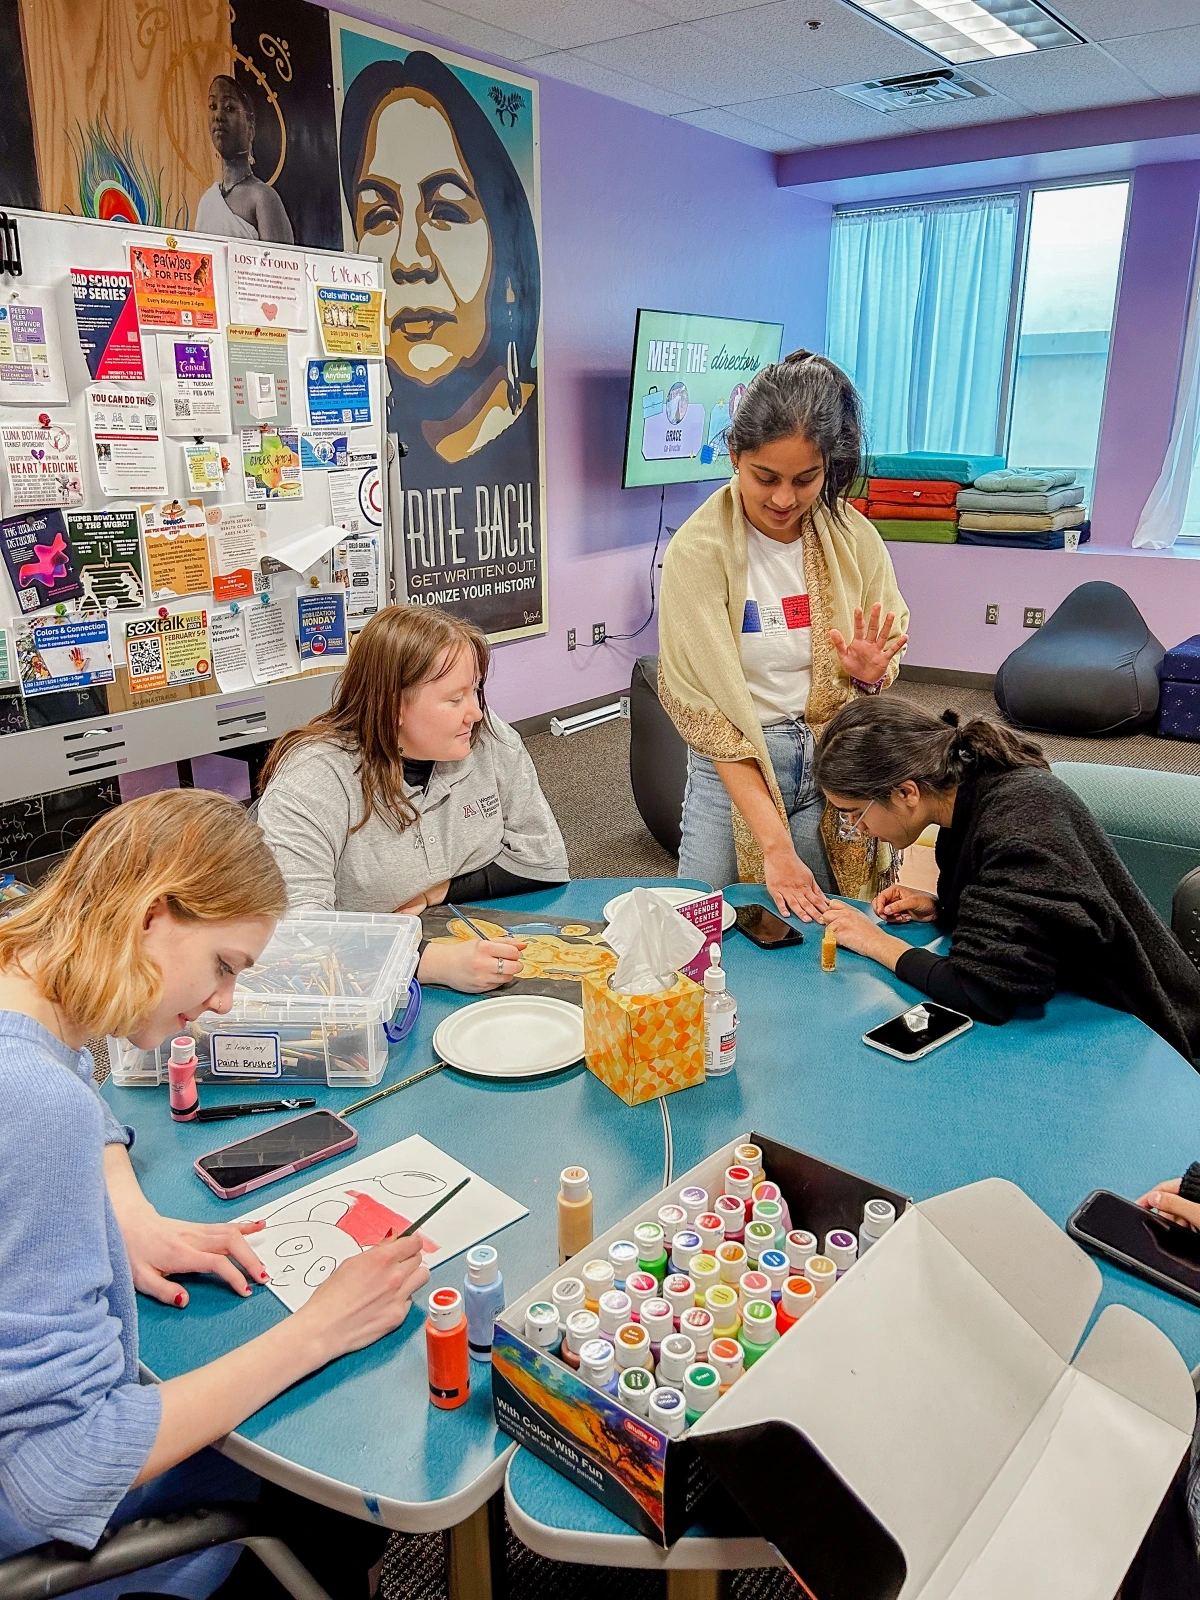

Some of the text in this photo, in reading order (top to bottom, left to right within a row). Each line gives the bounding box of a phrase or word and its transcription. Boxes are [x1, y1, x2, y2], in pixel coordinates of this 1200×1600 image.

[153, 254, 191, 270] Pa(w)se
[234, 254, 298, 270] LOST & FOUND
[71, 273, 132, 288] RAD SCHOOL
[156, 270, 192, 281] FOR PETS
[332, 266, 373, 286] EVENTS
[89, 288, 127, 300] SERIES
[320, 290, 336, 299] Chats
[350, 293, 368, 302] Cats!
[647, 340, 760, 374] MEET THE directors
[91, 394, 150, 405] YOU CAN DO THI
[3, 431, 52, 440] LUNA BOTANICA
[666, 430, 682, 442] GRACE
[9, 463, 79, 474] HEART MEDICINE
[163, 517, 185, 525] COUNCIL
[402, 483, 535, 569] RITE BACK
[3, 526, 17, 538] THE
[411, 559, 536, 588] GET WRITTEN OUT!
[408, 576, 536, 606] OLONIZE YOUR HISTORY
[303, 616, 336, 626] MONDAY
[36, 628, 59, 636] Colors
[66, 623, 106, 632] Connection
[212, 627, 240, 636] Women's
[164, 632, 195, 642] FEBRUARY
[212, 634, 239, 642] Network
[154, 693, 177, 701] STRAUSS
[98, 784, 116, 802] 24
[24, 801, 42, 816] 23
[463, 804, 477, 818] A
[694, 902, 719, 916] GENDER
[695, 910, 719, 924] CENTER
[688, 968, 698, 976] JUST
[217, 1058, 276, 1068] Paint Brushes
[500, 1418, 515, 1433] enjoy
[497, 1396, 603, 1480] With Color With Fun
[626, 1421, 658, 1447] Shuttle Art
[499, 1410, 524, 1432] Everyone
[526, 1429, 530, 1437] is
[540, 1440, 557, 1457] artist,
[559, 1454, 575, 1470] enjoy
[577, 1468, 604, 1492] painting.
